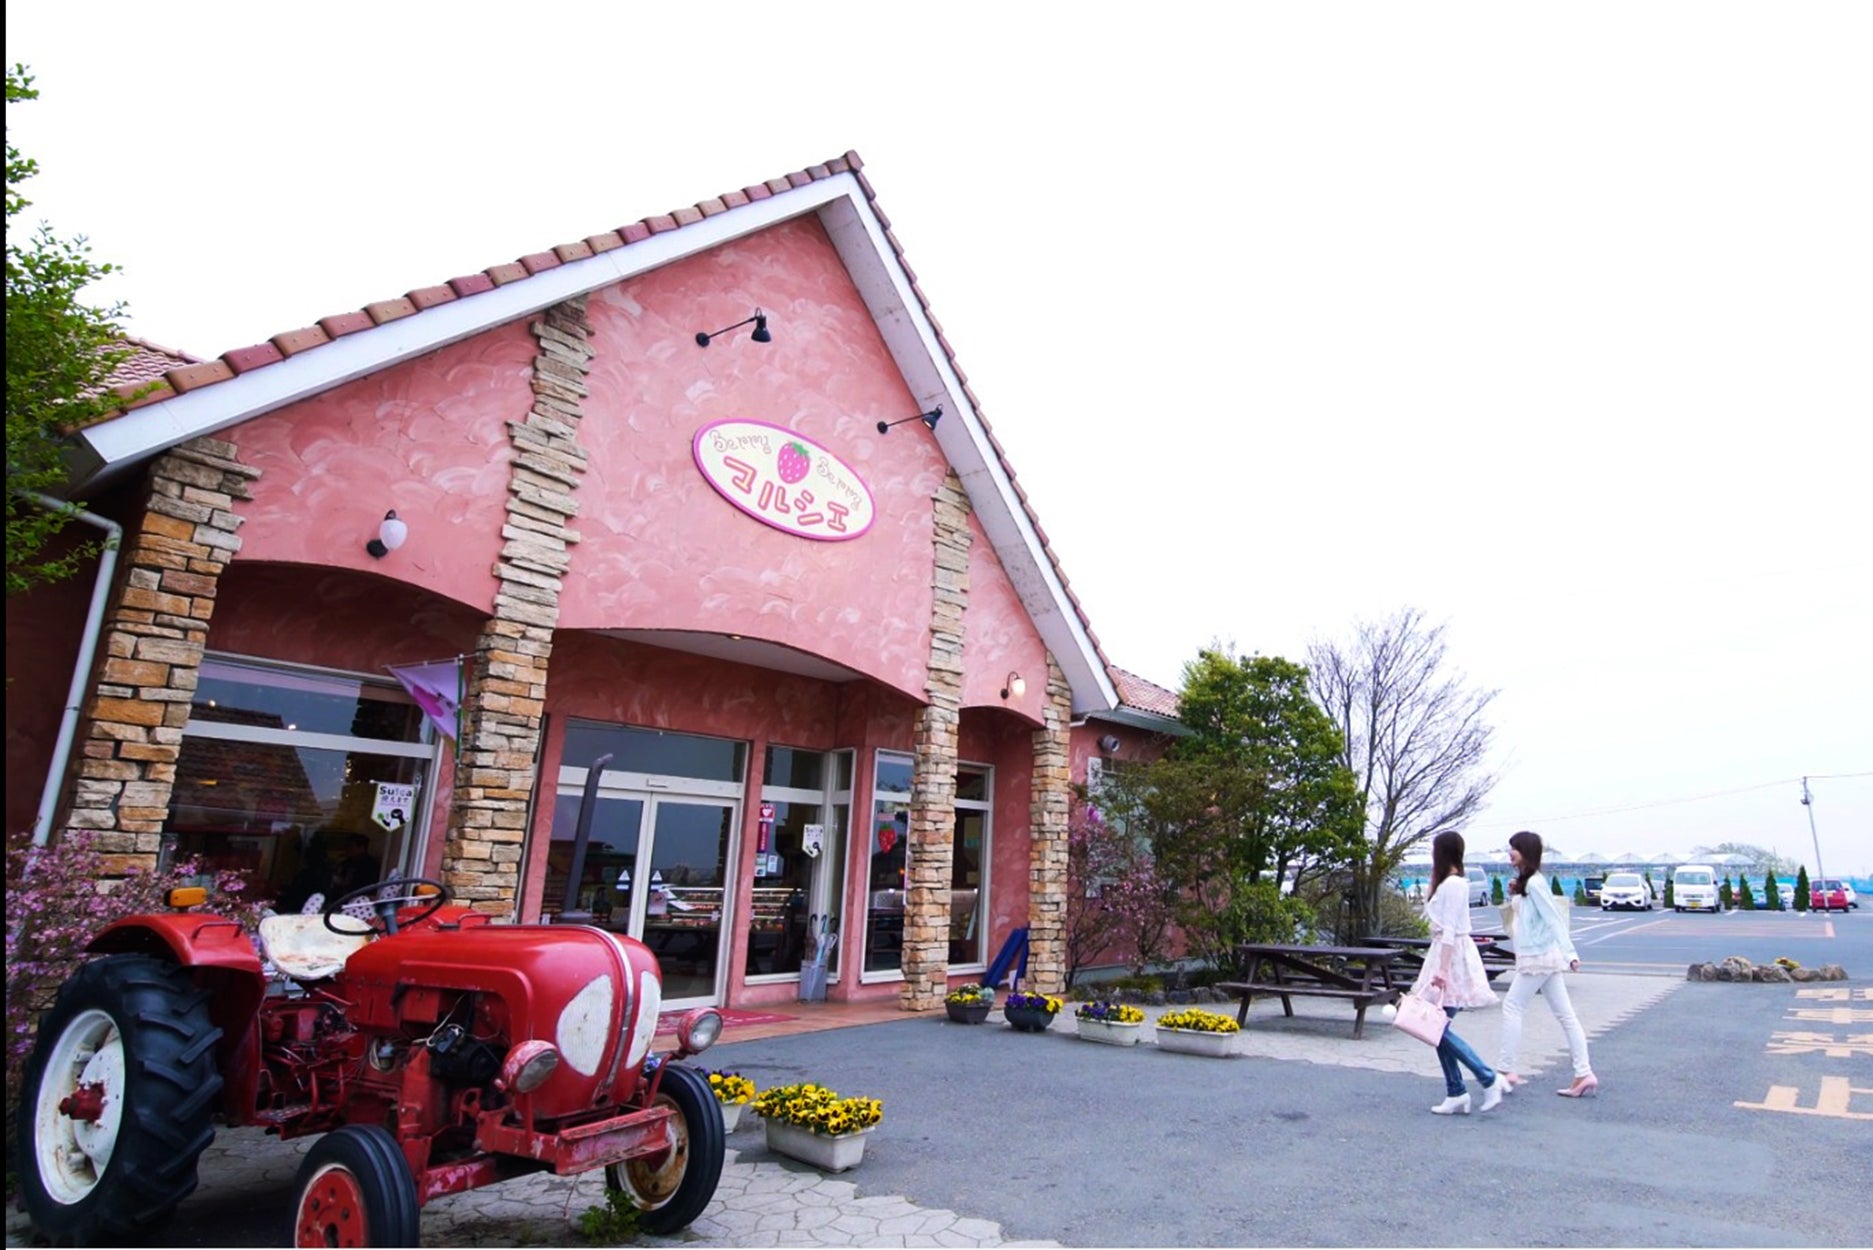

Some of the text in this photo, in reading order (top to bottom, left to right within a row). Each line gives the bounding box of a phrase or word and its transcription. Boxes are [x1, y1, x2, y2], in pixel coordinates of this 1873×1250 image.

[709, 429, 862, 511] Berry Berry
[723, 455, 849, 533] マルシェ
[379, 785, 412, 797] Suica
